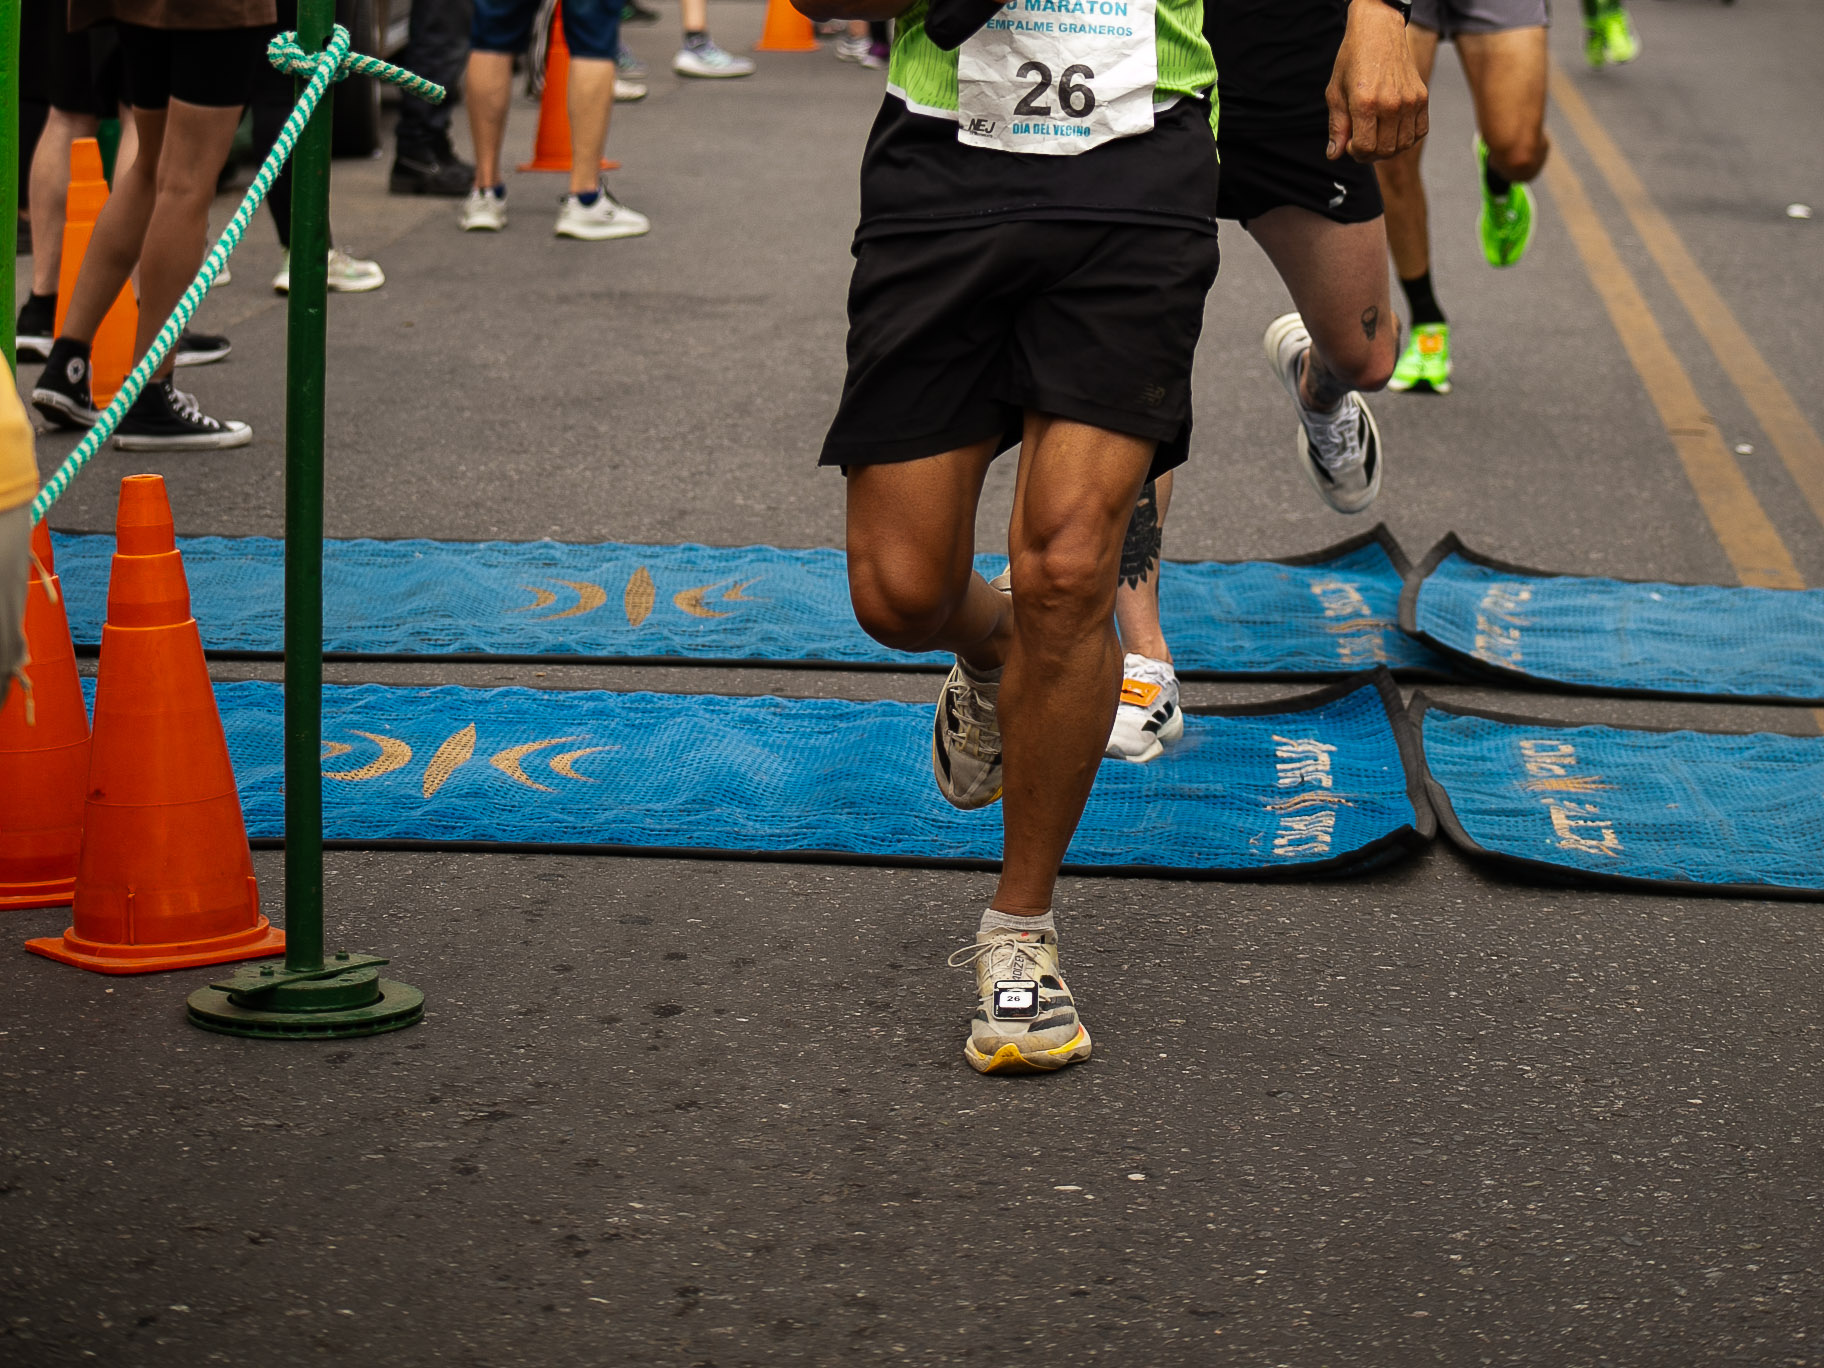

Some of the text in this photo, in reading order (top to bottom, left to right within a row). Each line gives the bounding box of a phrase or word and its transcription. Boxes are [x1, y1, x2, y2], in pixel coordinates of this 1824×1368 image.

[986, 18, 1133, 37] EMPALME GRANEROS
[1013, 60, 1096, 118] 26
[1012, 122, 1091, 138] DIA DEL VECINO
